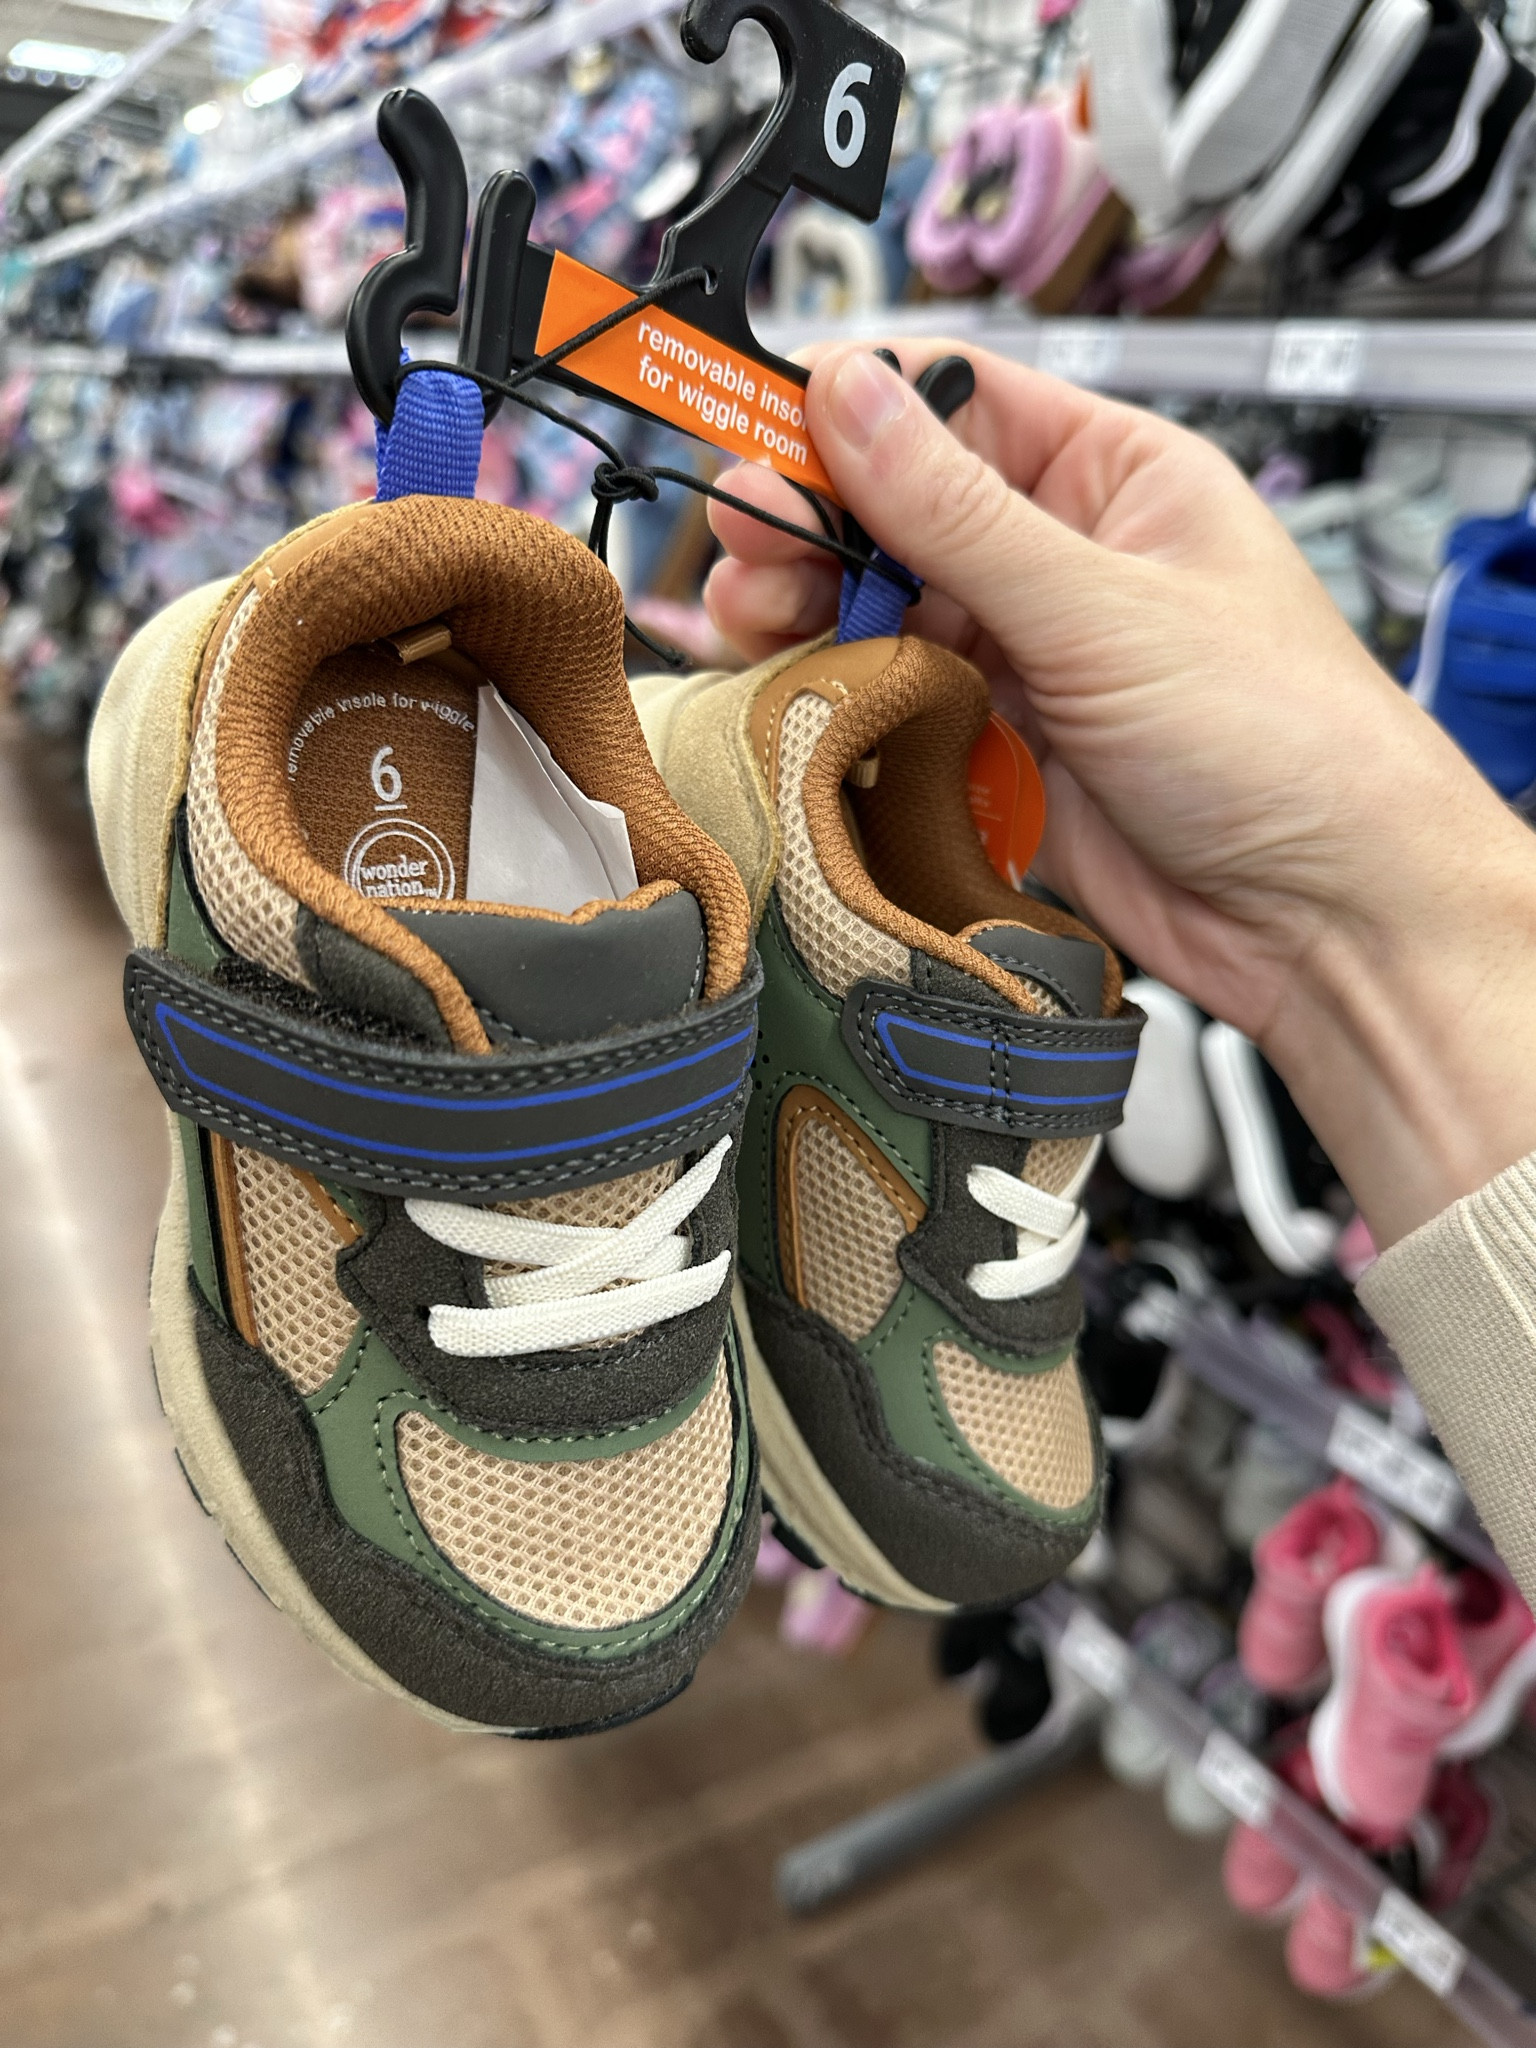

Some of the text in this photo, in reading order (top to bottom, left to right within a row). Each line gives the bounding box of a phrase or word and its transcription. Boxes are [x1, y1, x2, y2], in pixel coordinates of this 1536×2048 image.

[823, 62, 873, 169] 6
[637, 321, 756, 402] removable
[638, 354, 808, 466] for wiggle room
[287, 692, 475, 782] removable insole for wiggle
[371, 745, 403, 802] 6
[360, 854, 429, 880] wonder
[365, 878, 425, 898] nation
